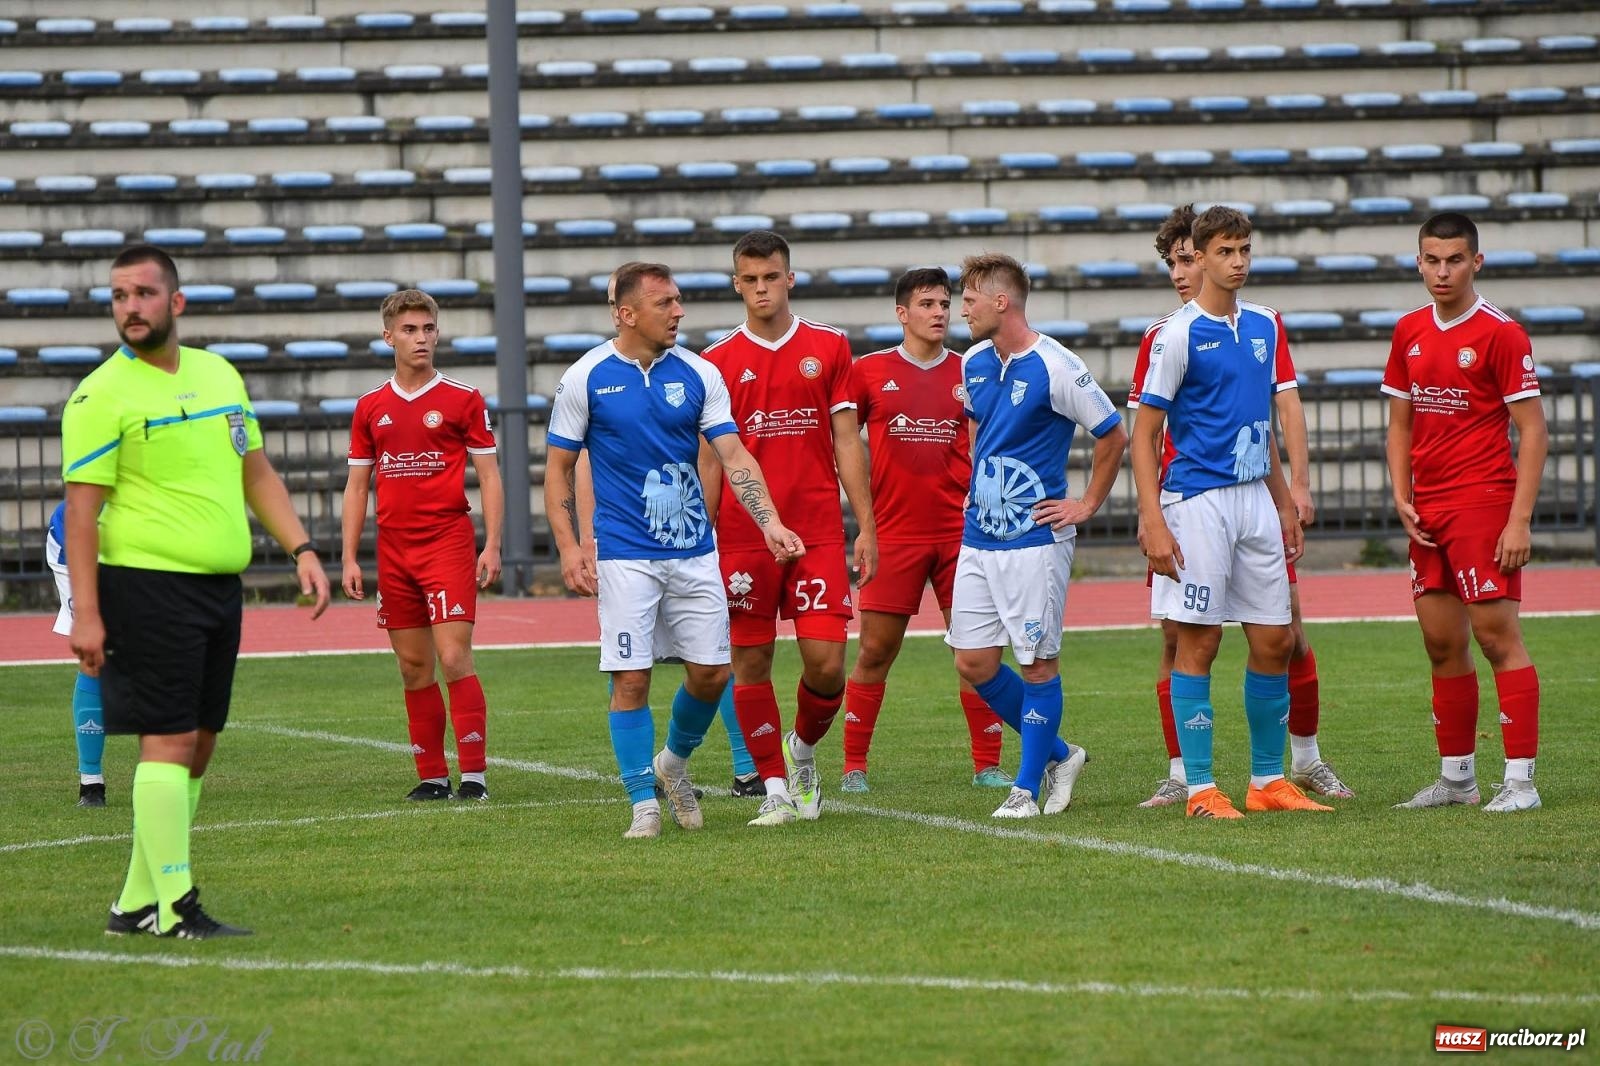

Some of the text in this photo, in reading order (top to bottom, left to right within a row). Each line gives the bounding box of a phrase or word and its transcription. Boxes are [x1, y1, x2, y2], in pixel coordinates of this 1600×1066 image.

[744, 408, 818, 424] AGAT
[379, 450, 444, 464] AGAT
[795, 578, 828, 612] 52
[1183, 583, 1211, 613] 99
[1457, 567, 1479, 599] 11
[427, 590, 448, 621] 51
[618, 632, 632, 659] 9
